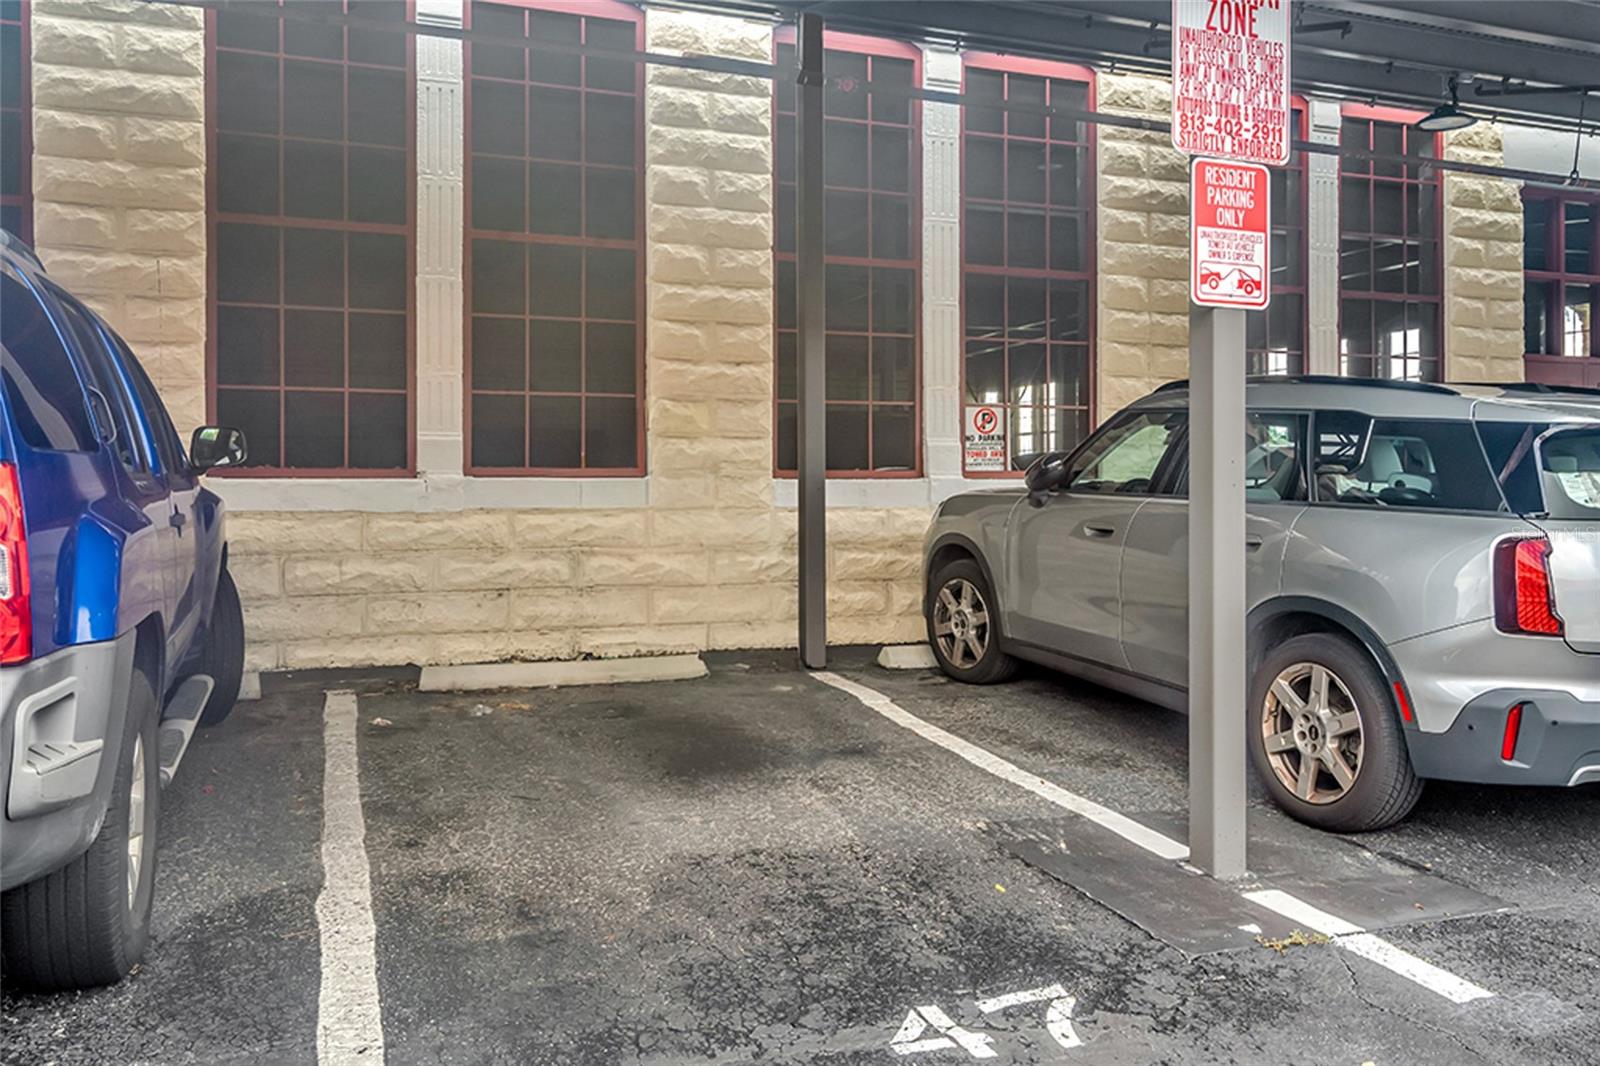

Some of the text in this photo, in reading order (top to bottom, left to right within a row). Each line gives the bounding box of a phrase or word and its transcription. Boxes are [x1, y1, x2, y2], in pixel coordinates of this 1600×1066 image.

[1206, 0, 1258, 38] ZONE
[1179, 26, 1284, 60] UNAUTHORIZED VEHICLES
[1180, 43, 1190, 61] OR
[1193, 46, 1225, 68] VESSELS
[1247, 55, 1256, 72] BE
[1180, 79, 1189, 96] 24
[1211, 84, 1217, 100] A
[1263, 91, 1269, 108] A
[1250, 71, 1283, 93] EXPENSE
[1215, 101, 1241, 120] TOWING
[1180, 113, 1283, 142] 813-402-2911
[1179, 129, 1226, 152] STRICTLY
[1231, 138, 1282, 160] ENFORCED
[1205, 166, 1257, 190] RESIDENT
[1207, 186, 1255, 209] PARKING
[1216, 207, 1245, 228] ONLY
[890, 983, 1085, 1058] 47
